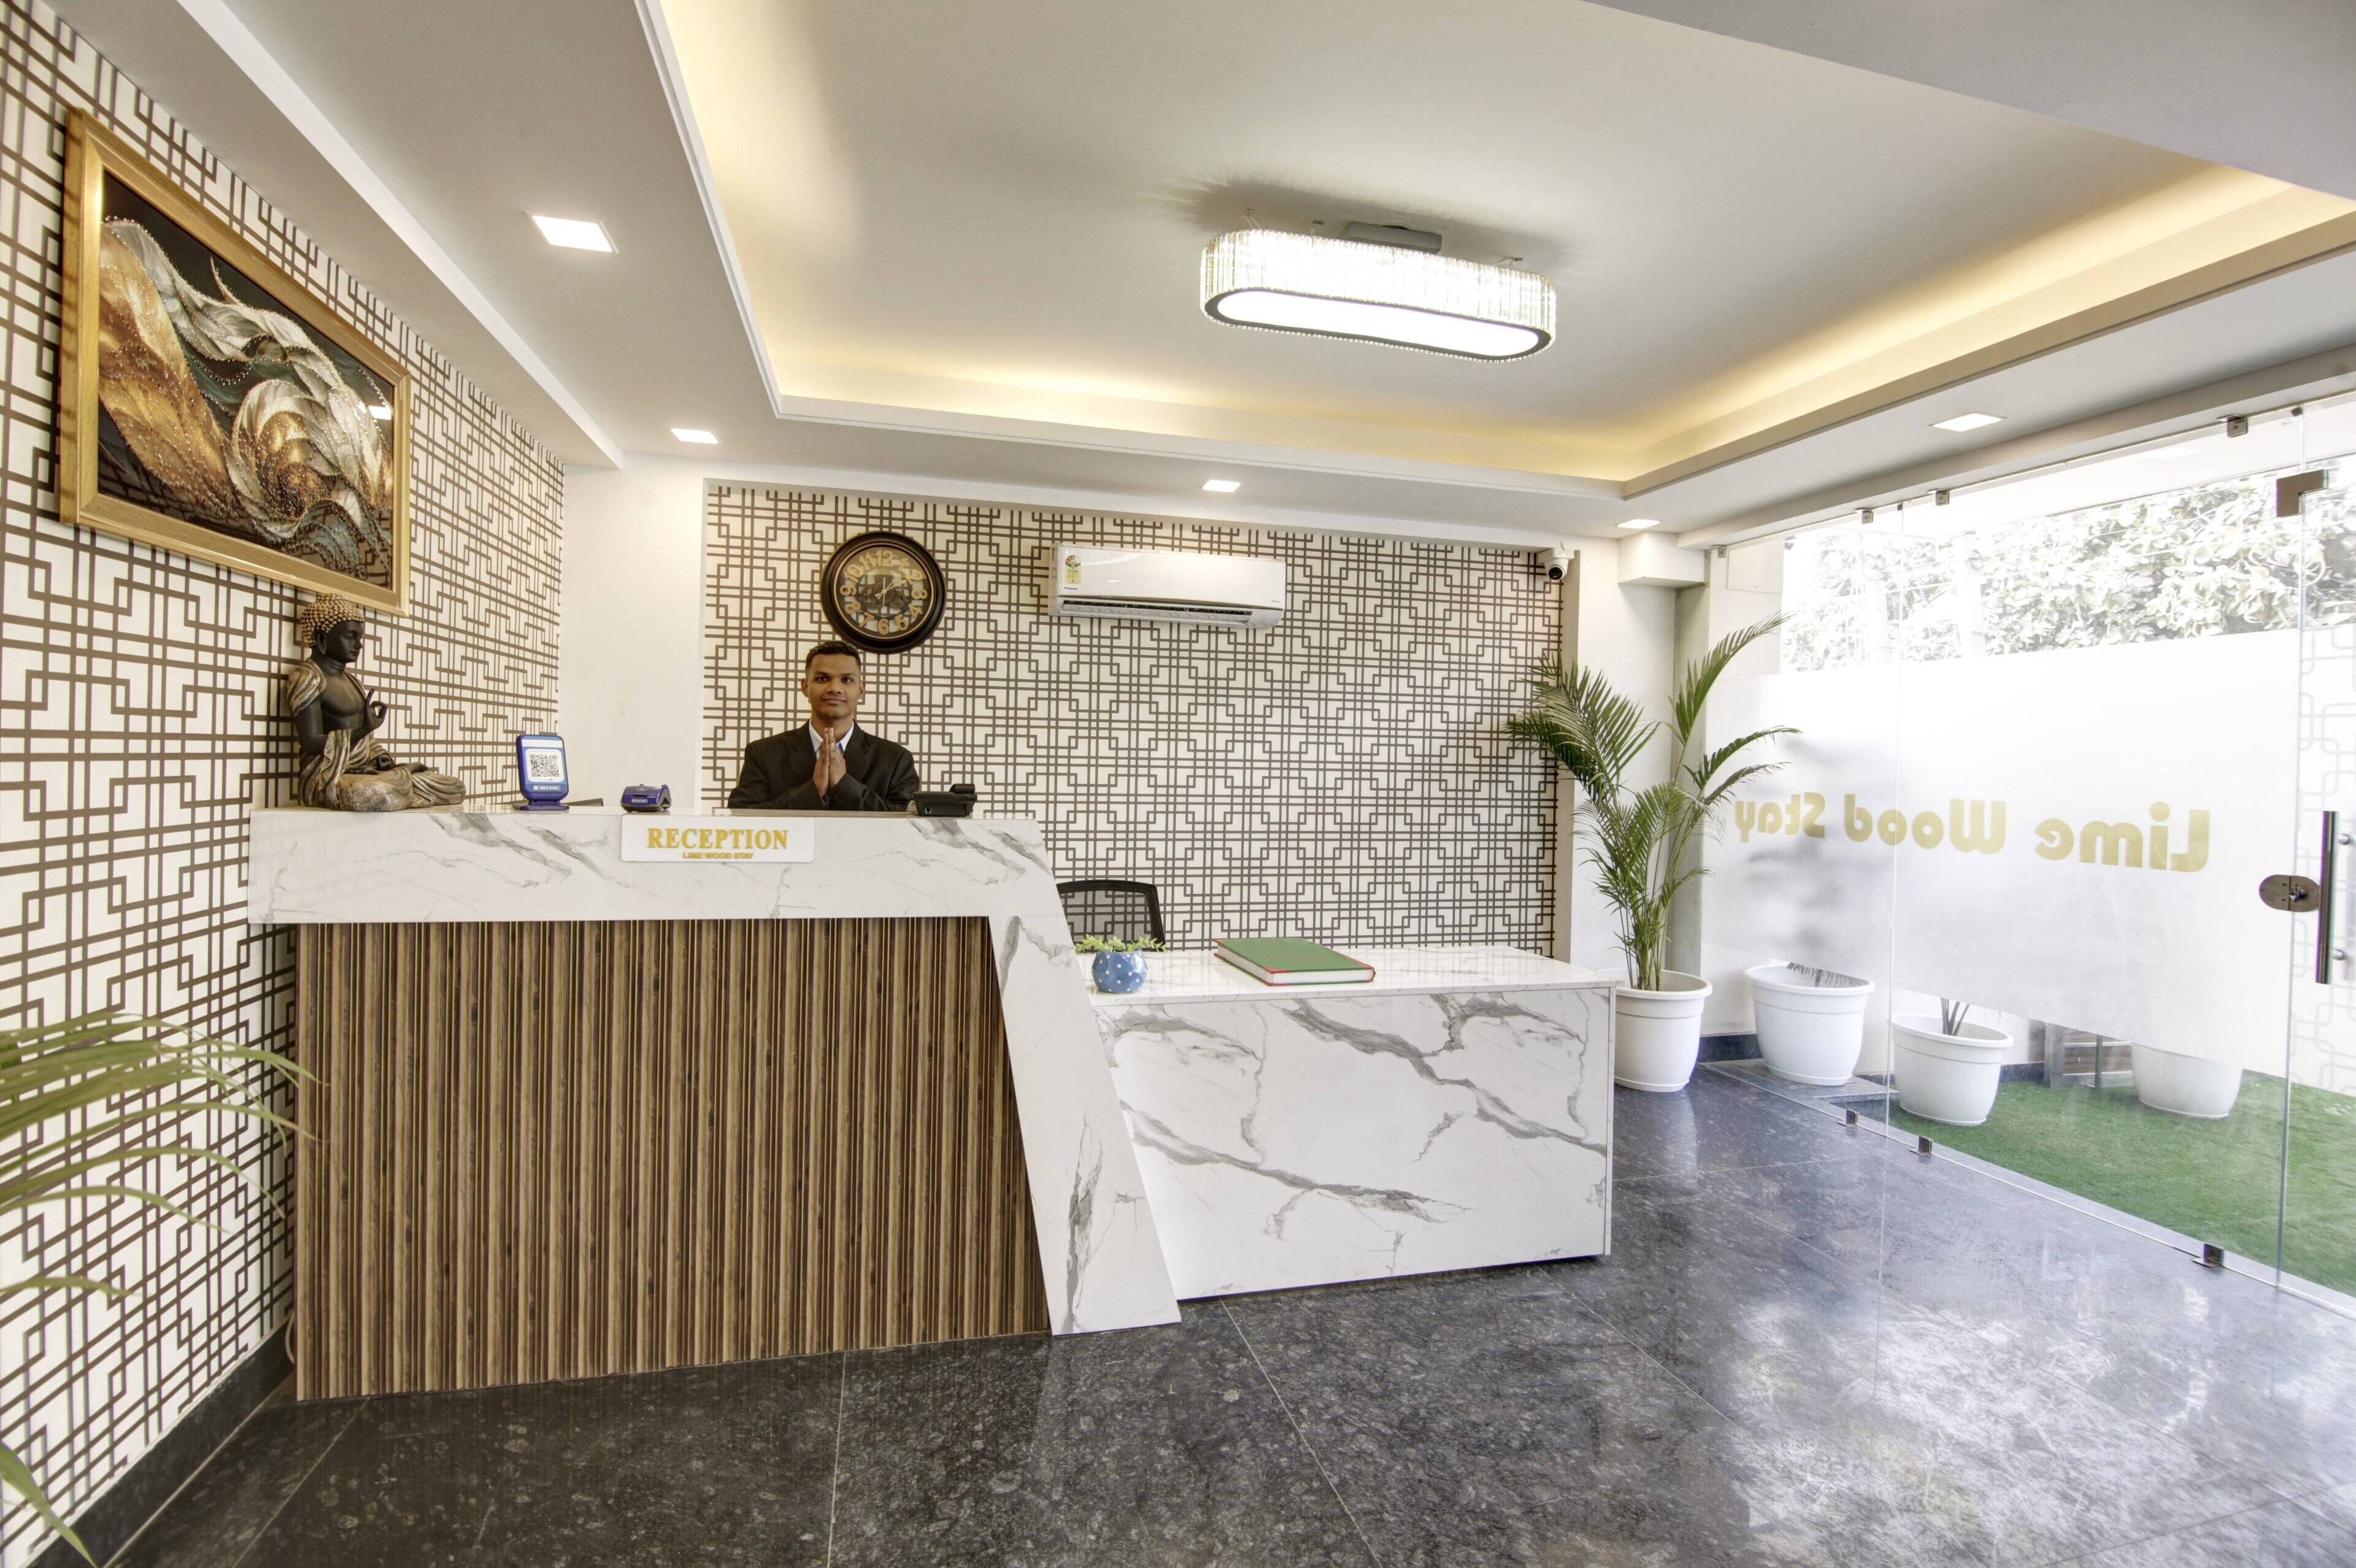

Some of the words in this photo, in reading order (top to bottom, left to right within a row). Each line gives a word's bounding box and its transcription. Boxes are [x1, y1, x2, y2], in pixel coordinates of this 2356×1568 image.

[859, 551, 877, 571] 11
[876, 549, 894, 566] 12
[898, 557, 909, 571] 1
[844, 564, 864, 582] 10
[839, 584, 857, 596] 9
[911, 589, 928, 599] 3
[844, 601, 861, 615] 8
[909, 603, 923, 618] 4
[859, 611, 875, 628] 7
[878, 618, 890, 635] 6
[647, 828, 789, 850] RECEPTION
